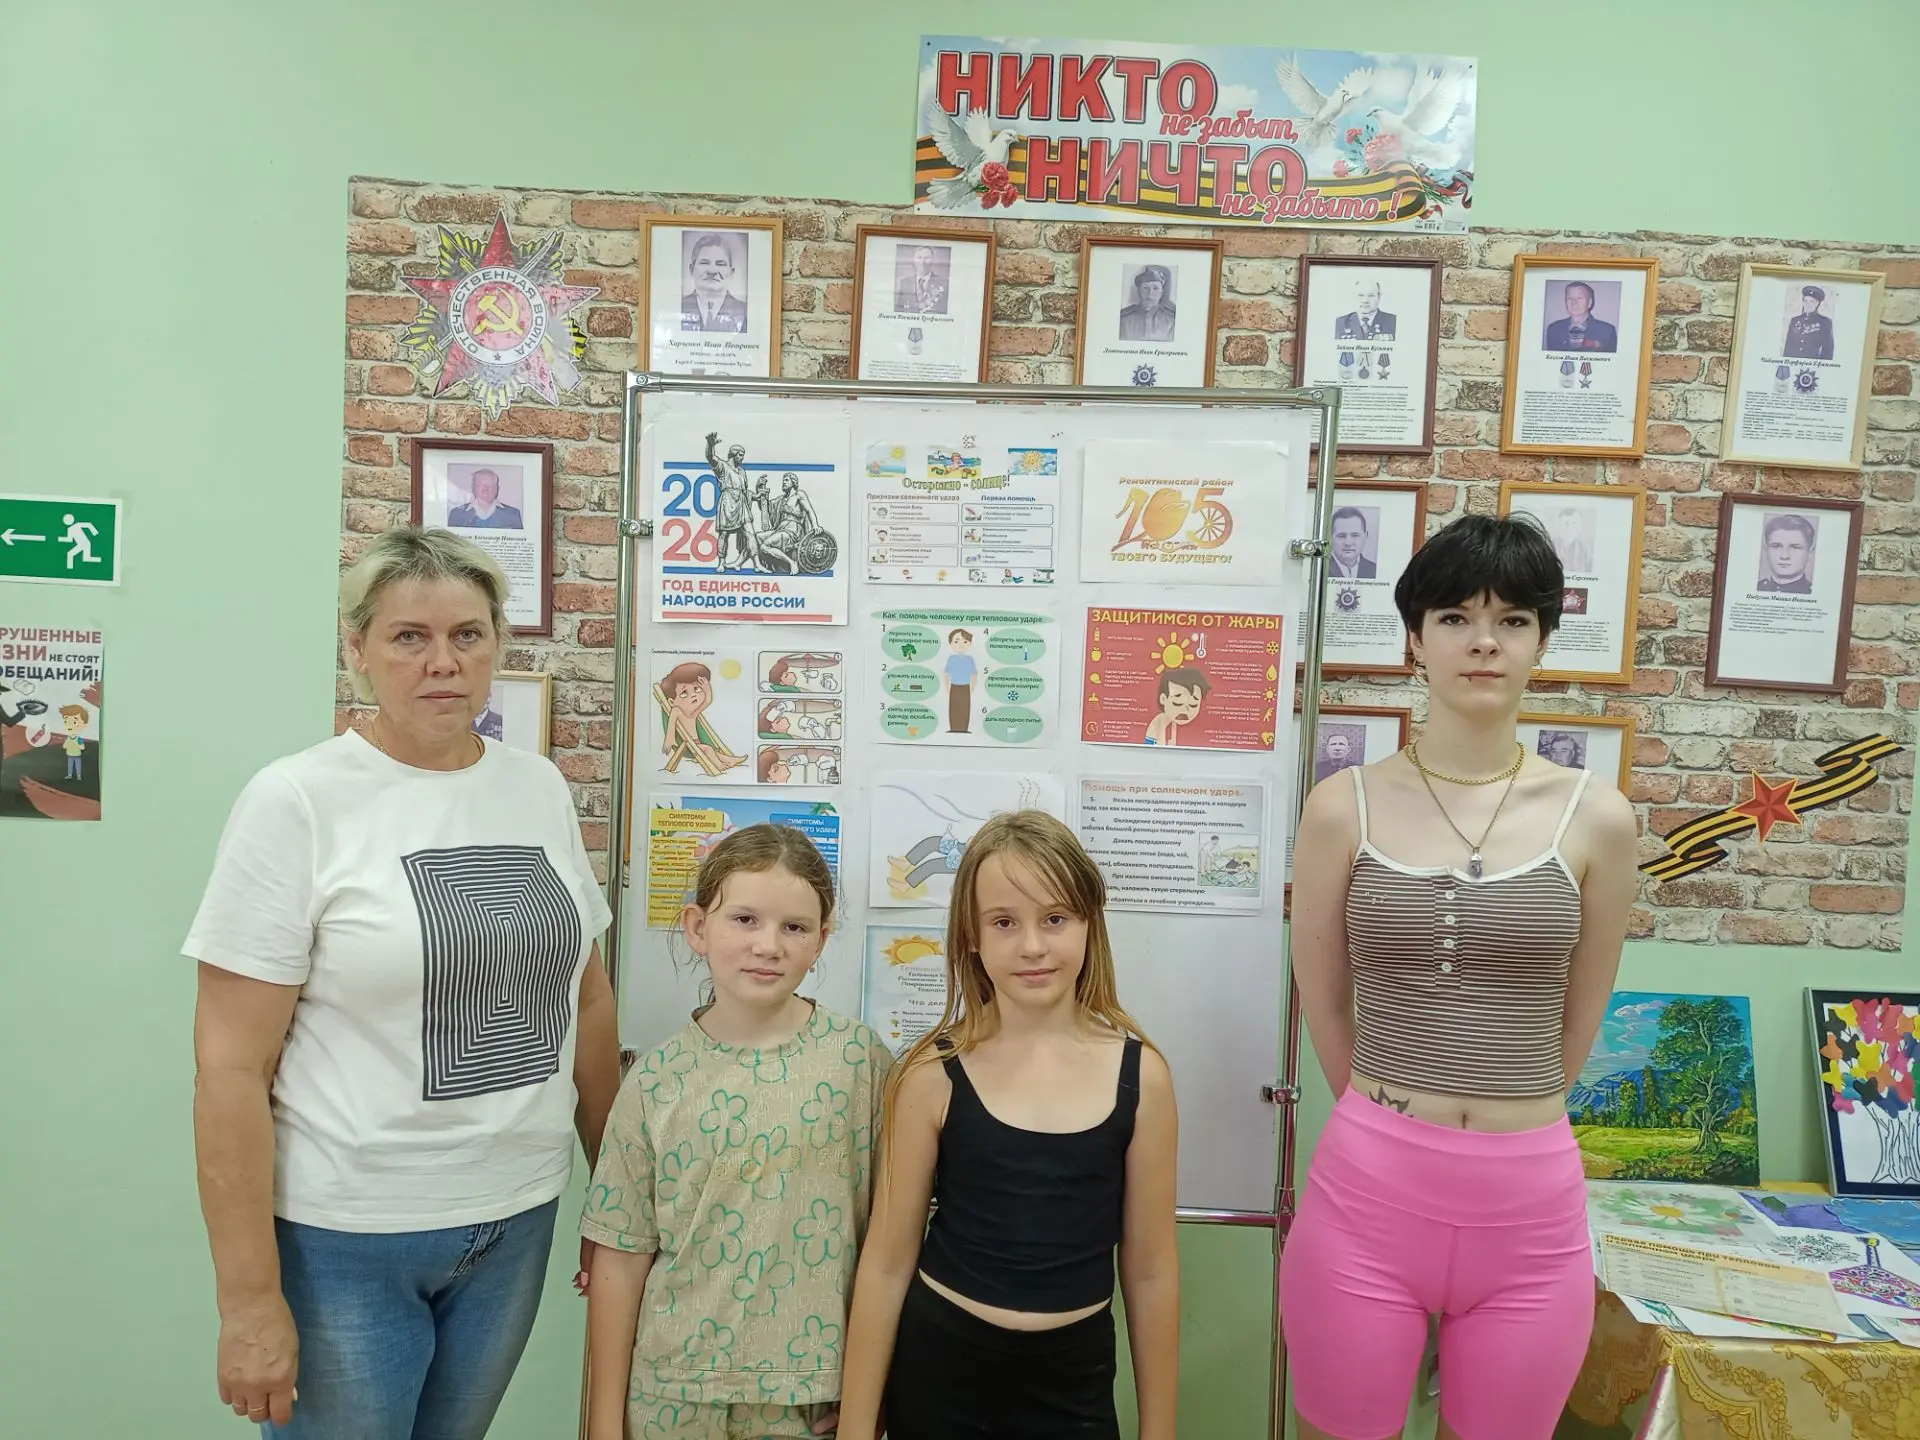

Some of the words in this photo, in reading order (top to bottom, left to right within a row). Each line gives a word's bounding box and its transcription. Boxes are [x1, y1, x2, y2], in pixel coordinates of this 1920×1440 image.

[936, 50, 1218, 124] НИКТО
[1160, 112, 1193, 138] не
[1196, 114, 1299, 146] забыт,
[1025, 136, 1309, 208] НИЧТО
[1221, 192, 1257, 217] не
[1263, 190, 1381, 225] забыто
[451, 271, 537, 354] ОТЕЧЕСТВЕННАЯ
[1202, 478, 1234, 487] район
[662, 474, 720, 518] 20
[662, 518, 719, 562] 26
[1111, 552, 1157, 562] ТВОЕГО
[1159, 553, 1233, 564] БУДУЩЕГО!
[662, 580, 694, 593] ГОД
[699, 580, 781, 593] ЕДИНСТВА
[662, 595, 737, 608] НАРОДОВ
[742, 597, 805, 609] РОССИИ
[882, 611, 896, 619] Как
[899, 613, 928, 621] помочь
[930, 614, 965, 622] человеку
[982, 615, 1019, 623] тепловом
[1020, 616, 1043, 624] ударе
[1092, 609, 1197, 626] ЗАЩИТИМСЯ
[1202, 615, 1224, 625] ОТ
[1229, 616, 1279, 630] ЖАРЫ
[881, 624, 886, 632] 1
[49, 654, 63, 662] НЕ
[65, 654, 100, 663] СТОЯТ
[982, 706, 988, 714] 6
[1085, 783, 1126, 793] Помощь
[1151, 787, 1207, 795] солнечном
[1606, 1234, 1647, 1246] Первая
[1649, 1242, 1696, 1255] помощь
[1699, 1250, 1720, 1259] при
[1724, 1255, 1781, 1270] тепловом
